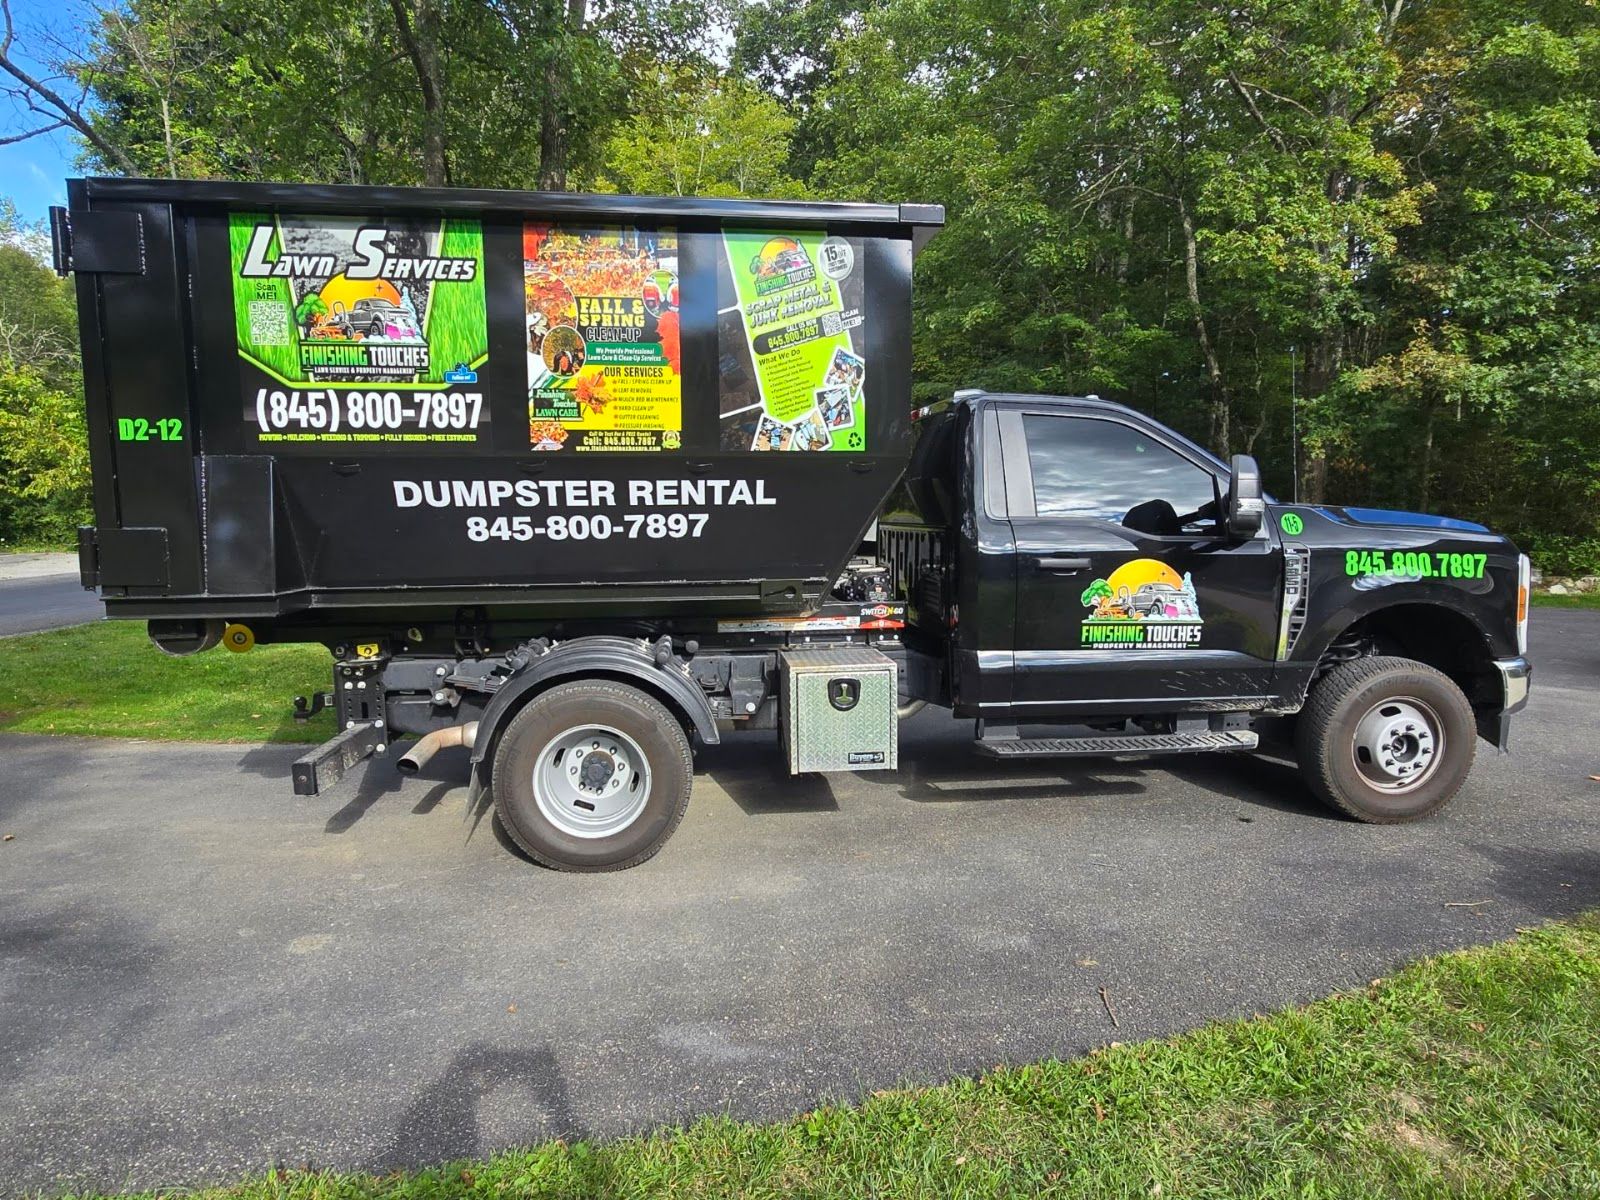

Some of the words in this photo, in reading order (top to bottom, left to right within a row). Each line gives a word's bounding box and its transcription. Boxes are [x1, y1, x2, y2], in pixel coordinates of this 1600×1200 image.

[824, 245, 838, 262] 15
[256, 283, 277, 291] Scan
[756, 275, 789, 294] FINISHING
[787, 267, 816, 283] TOUCHES
[256, 292, 277, 300] ME!
[746, 295, 783, 316] SCRAP
[784, 284, 820, 304] METAL
[822, 281, 832, 293] &
[579, 298, 625, 314] FALL
[632, 299, 645, 314] &
[750, 308, 780, 328] JUNK
[781, 294, 834, 320] REMOVAL
[841, 309, 859, 319] SCAN
[579, 314, 646, 328] SPRING
[786, 323, 798, 332] CALL
[586, 327, 642, 342] CLEAN-UP
[767, 324, 819, 348] 845.800.7897
[301, 345, 368, 365] FINISHING
[369, 346, 429, 367] TOUCHES
[758, 355, 777, 366] What
[778, 352, 790, 360] We
[791, 349, 801, 357] Do
[604, 367, 621, 377] OUR
[624, 367, 664, 377] SERVICES
[536, 389, 565, 400] Finishing
[256, 389, 340, 432] (845)
[346, 391, 483, 430] 800-7897
[553, 399, 578, 408] Touches
[536, 408, 558, 417] LAWN
[559, 408, 578, 417] CARE
[118, 418, 183, 441] D2-12
[385, 433, 402, 442] FULLY
[583, 436, 602, 446] Call:
[392, 479, 617, 508] DUMPSTER
[628, 479, 777, 506] RENTAL
[466, 513, 710, 542] 845-800-7897
[1284, 516, 1299, 532] 11-5
[1345, 551, 1488, 579] 845.800.7897
[1081, 625, 1144, 642] FINISHING
[1146, 625, 1202, 642] TOUCHES
